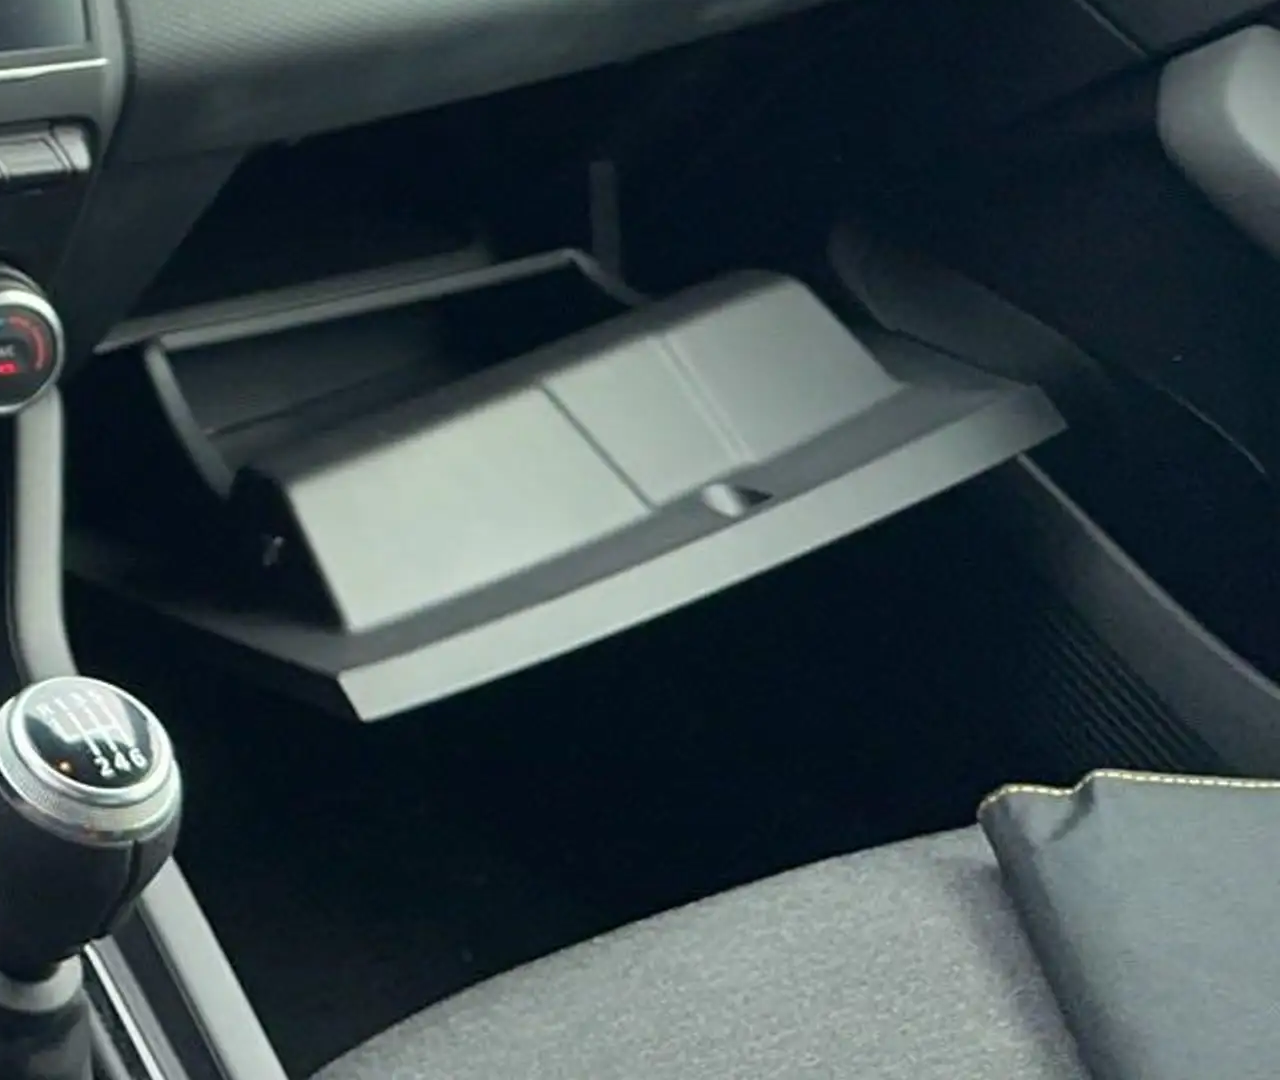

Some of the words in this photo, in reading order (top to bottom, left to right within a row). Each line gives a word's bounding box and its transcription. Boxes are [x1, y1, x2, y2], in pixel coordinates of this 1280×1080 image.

[94, 756, 115, 777] 2
[114, 751, 131, 771] 4
[128, 747, 147, 769] 6
